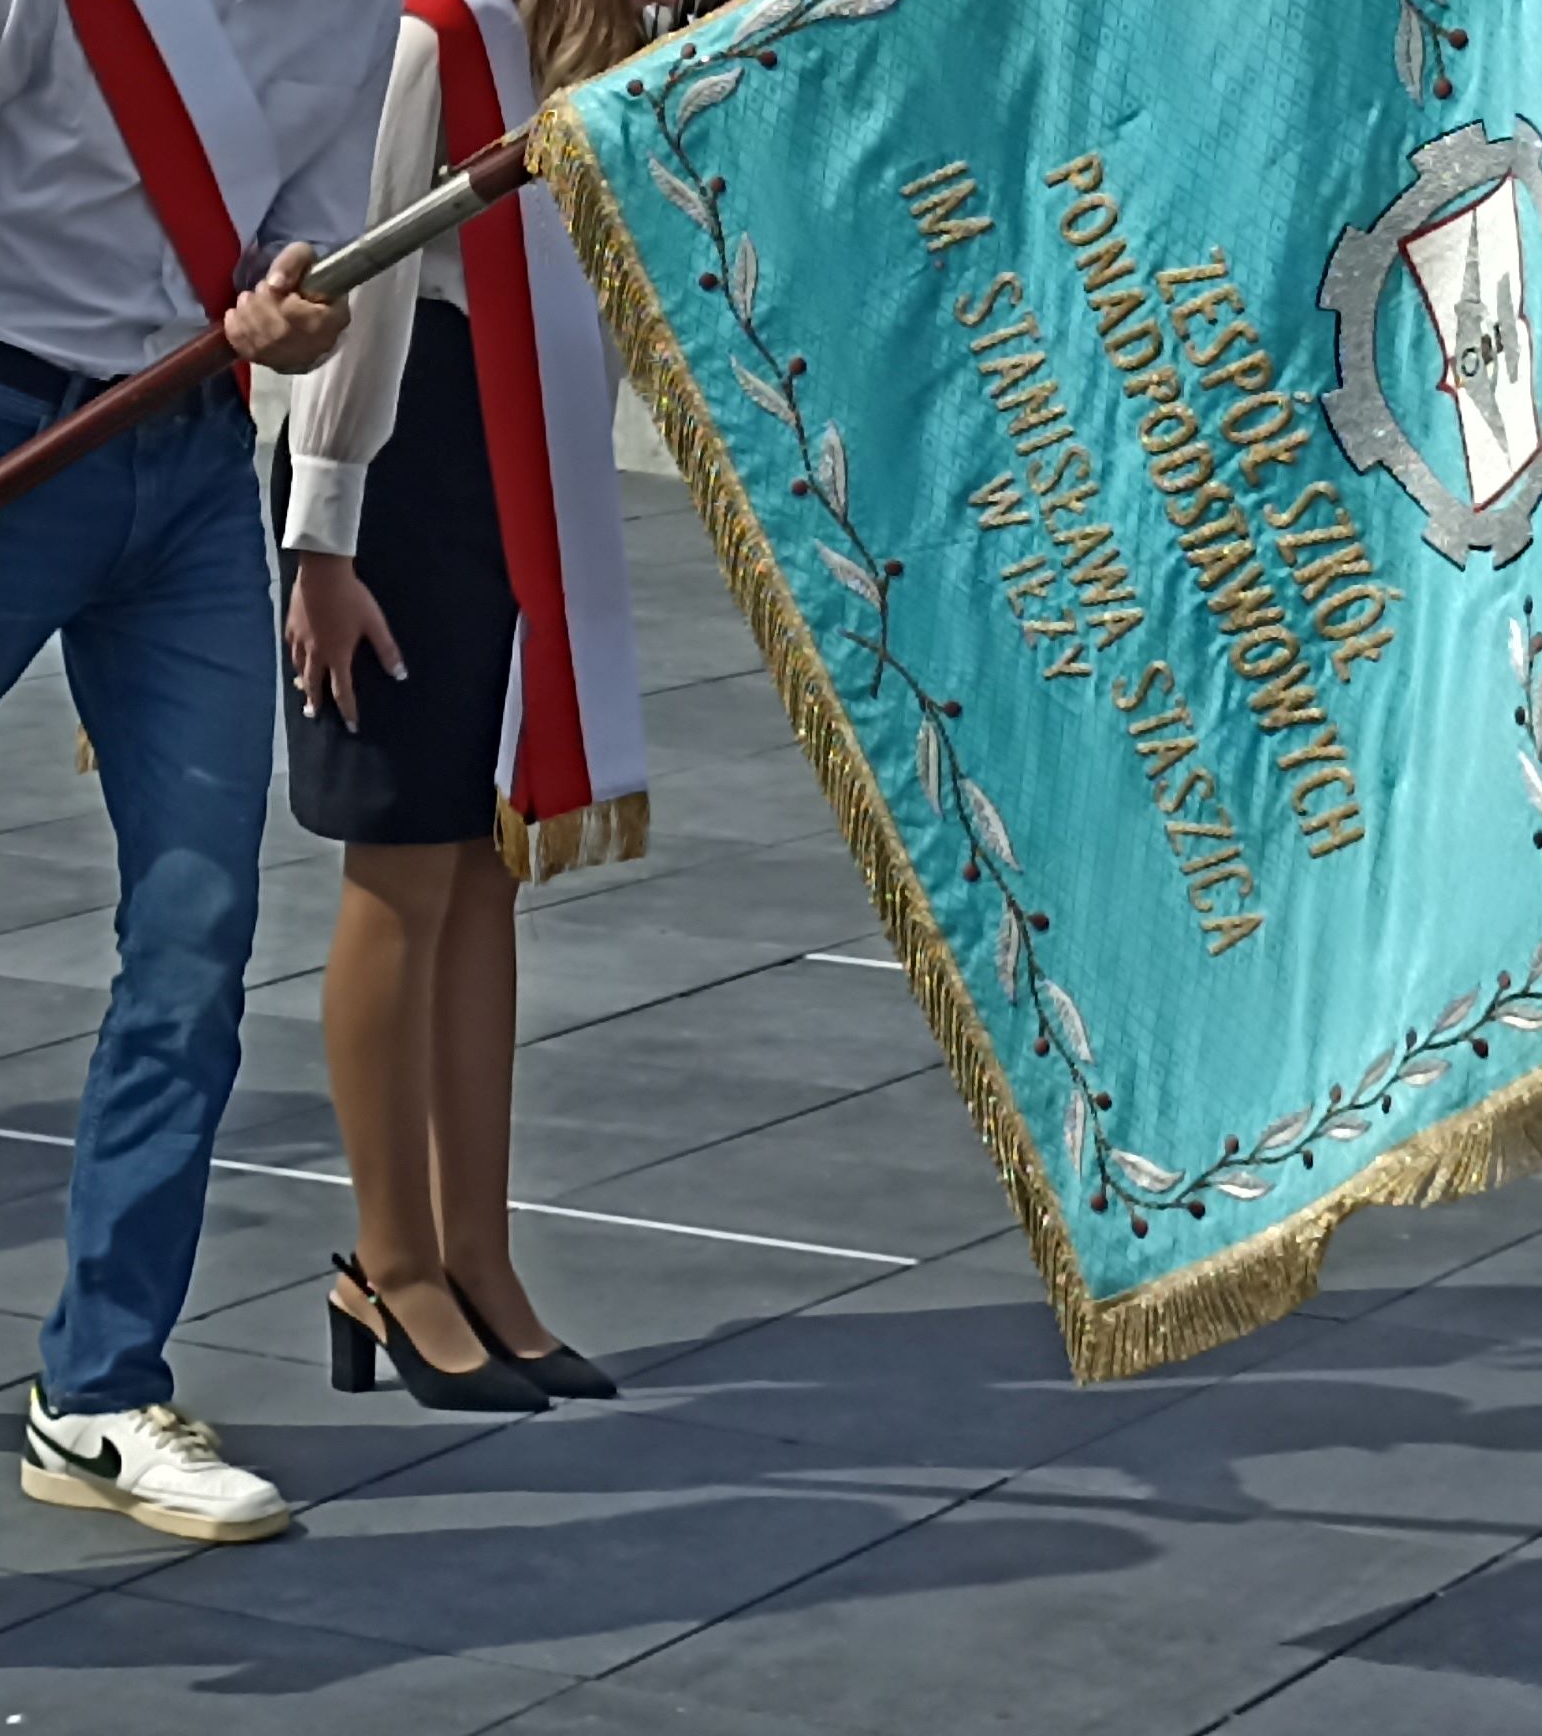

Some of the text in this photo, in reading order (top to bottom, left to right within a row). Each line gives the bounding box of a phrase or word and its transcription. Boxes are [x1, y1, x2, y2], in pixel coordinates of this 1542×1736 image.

[899, 160, 1265, 958] IM. STANISŁAWA STASZICA
[967, 470, 1032, 531] W
[1044, 151, 1365, 860] PONADPODSTAWOWYCH
[1155, 245, 1404, 683] ZESPÓŁ SZKÓŁ
